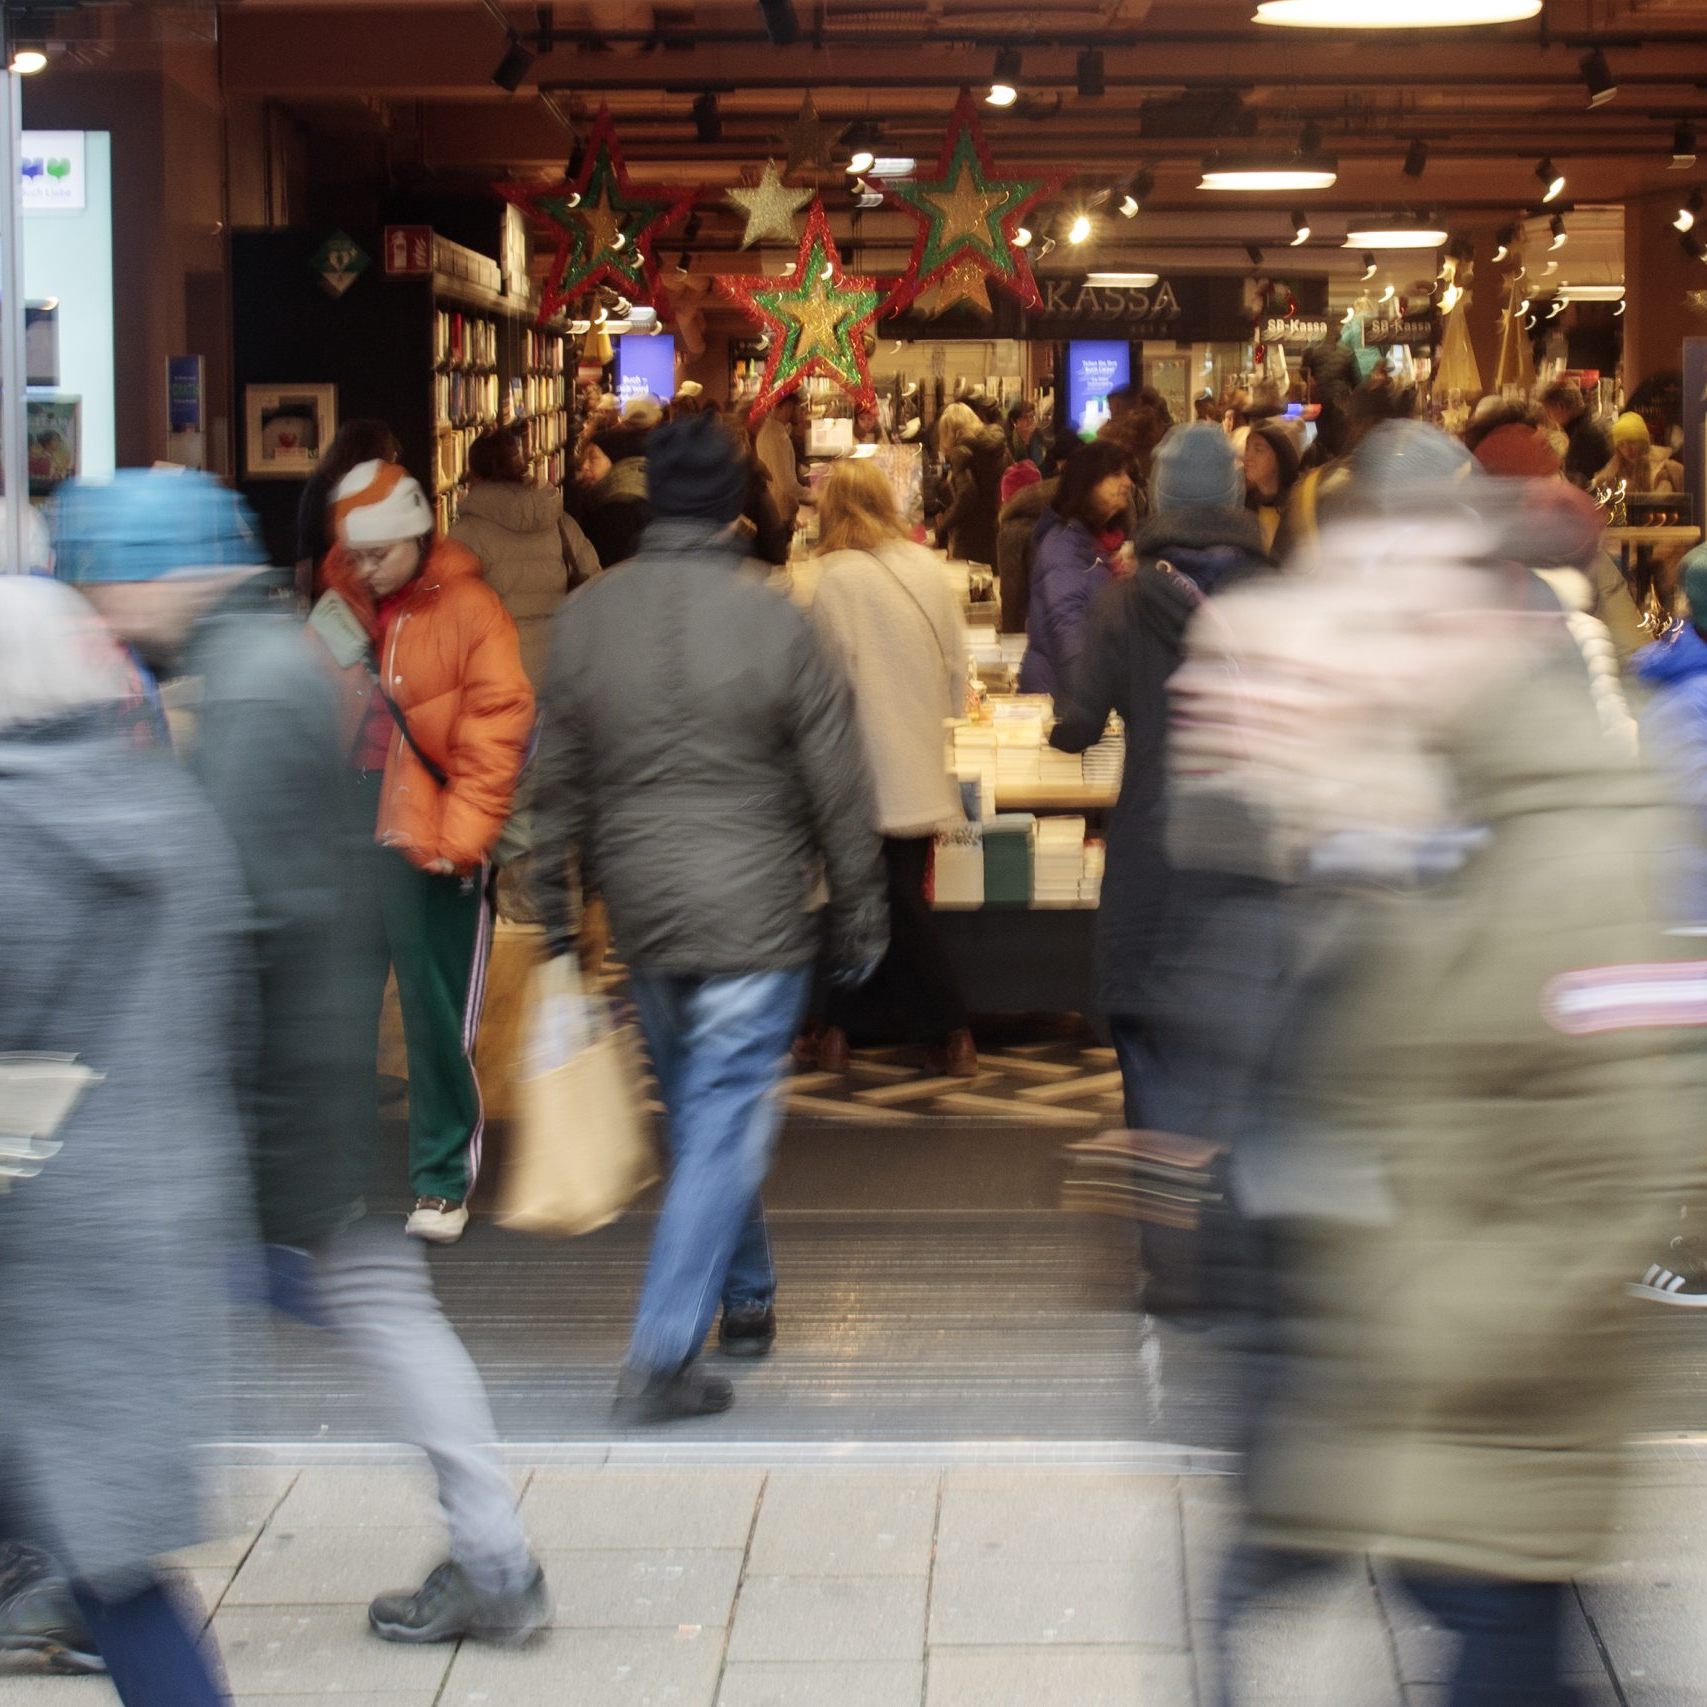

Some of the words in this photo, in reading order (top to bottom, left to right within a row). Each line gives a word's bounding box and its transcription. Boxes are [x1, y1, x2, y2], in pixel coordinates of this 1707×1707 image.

[1045, 280, 1181, 313] KASSA
[1267, 318, 1328, 332] SB-Kassa
[1371, 319, 1432, 332] SB-Kassa
